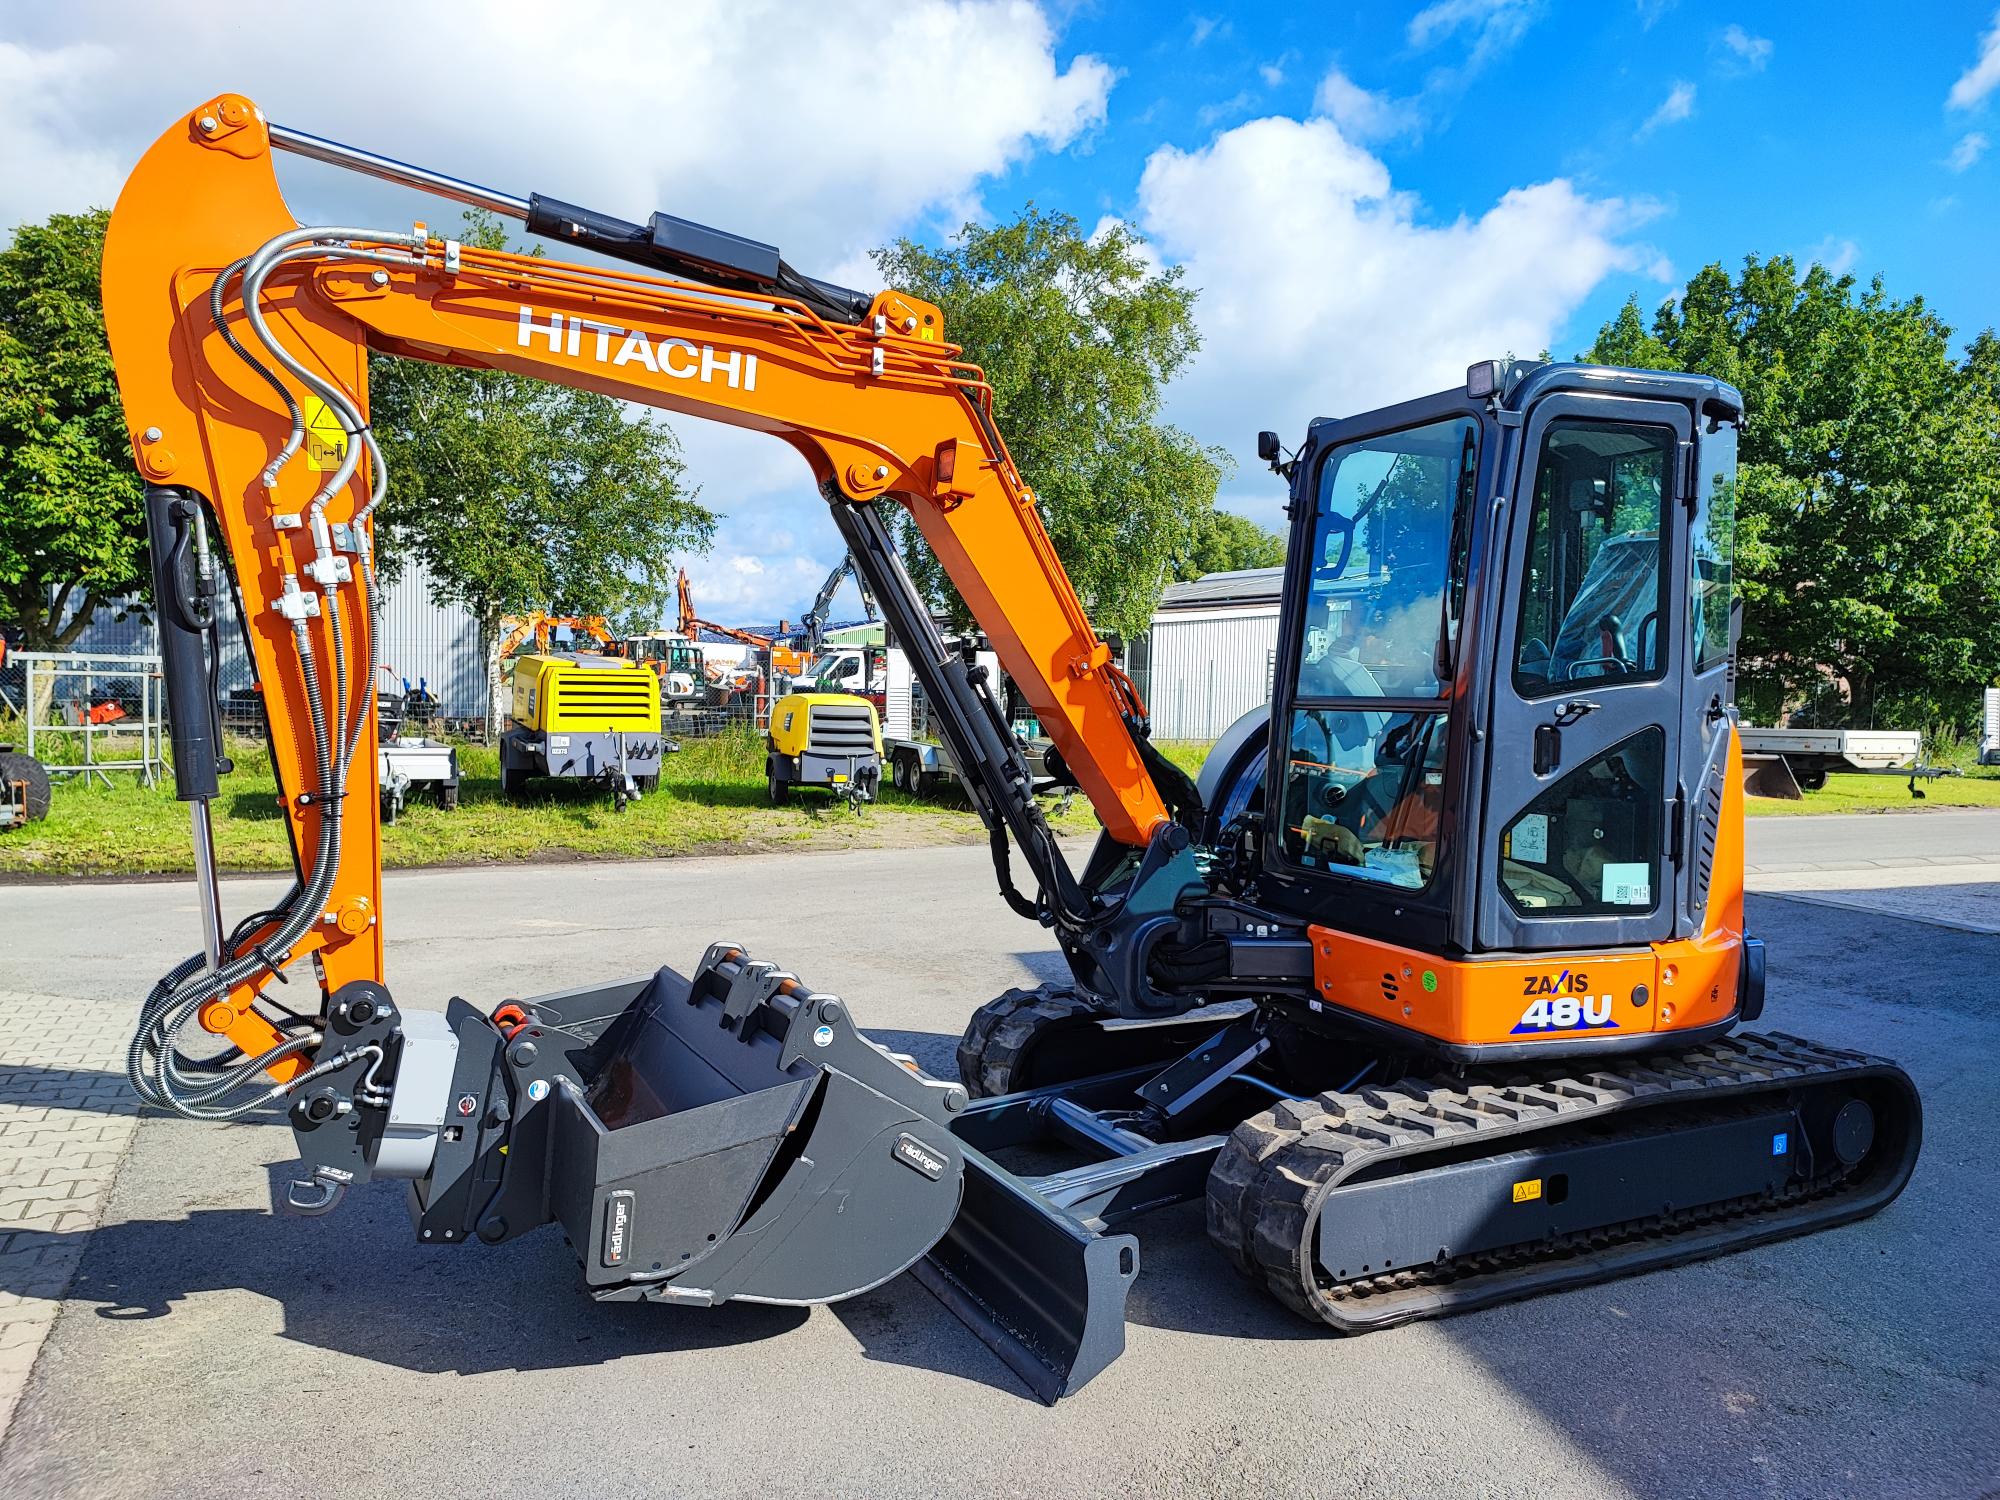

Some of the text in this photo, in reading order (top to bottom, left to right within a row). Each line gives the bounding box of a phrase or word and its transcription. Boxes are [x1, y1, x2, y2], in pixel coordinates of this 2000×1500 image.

[517, 306, 758, 392] HITACHI
[1524, 970, 1589, 996] ZAXIS
[1521, 995, 1613, 1029] 48U
[900, 1143, 943, 1172] rädlinger
[610, 1201, 627, 1261] rädlinger
